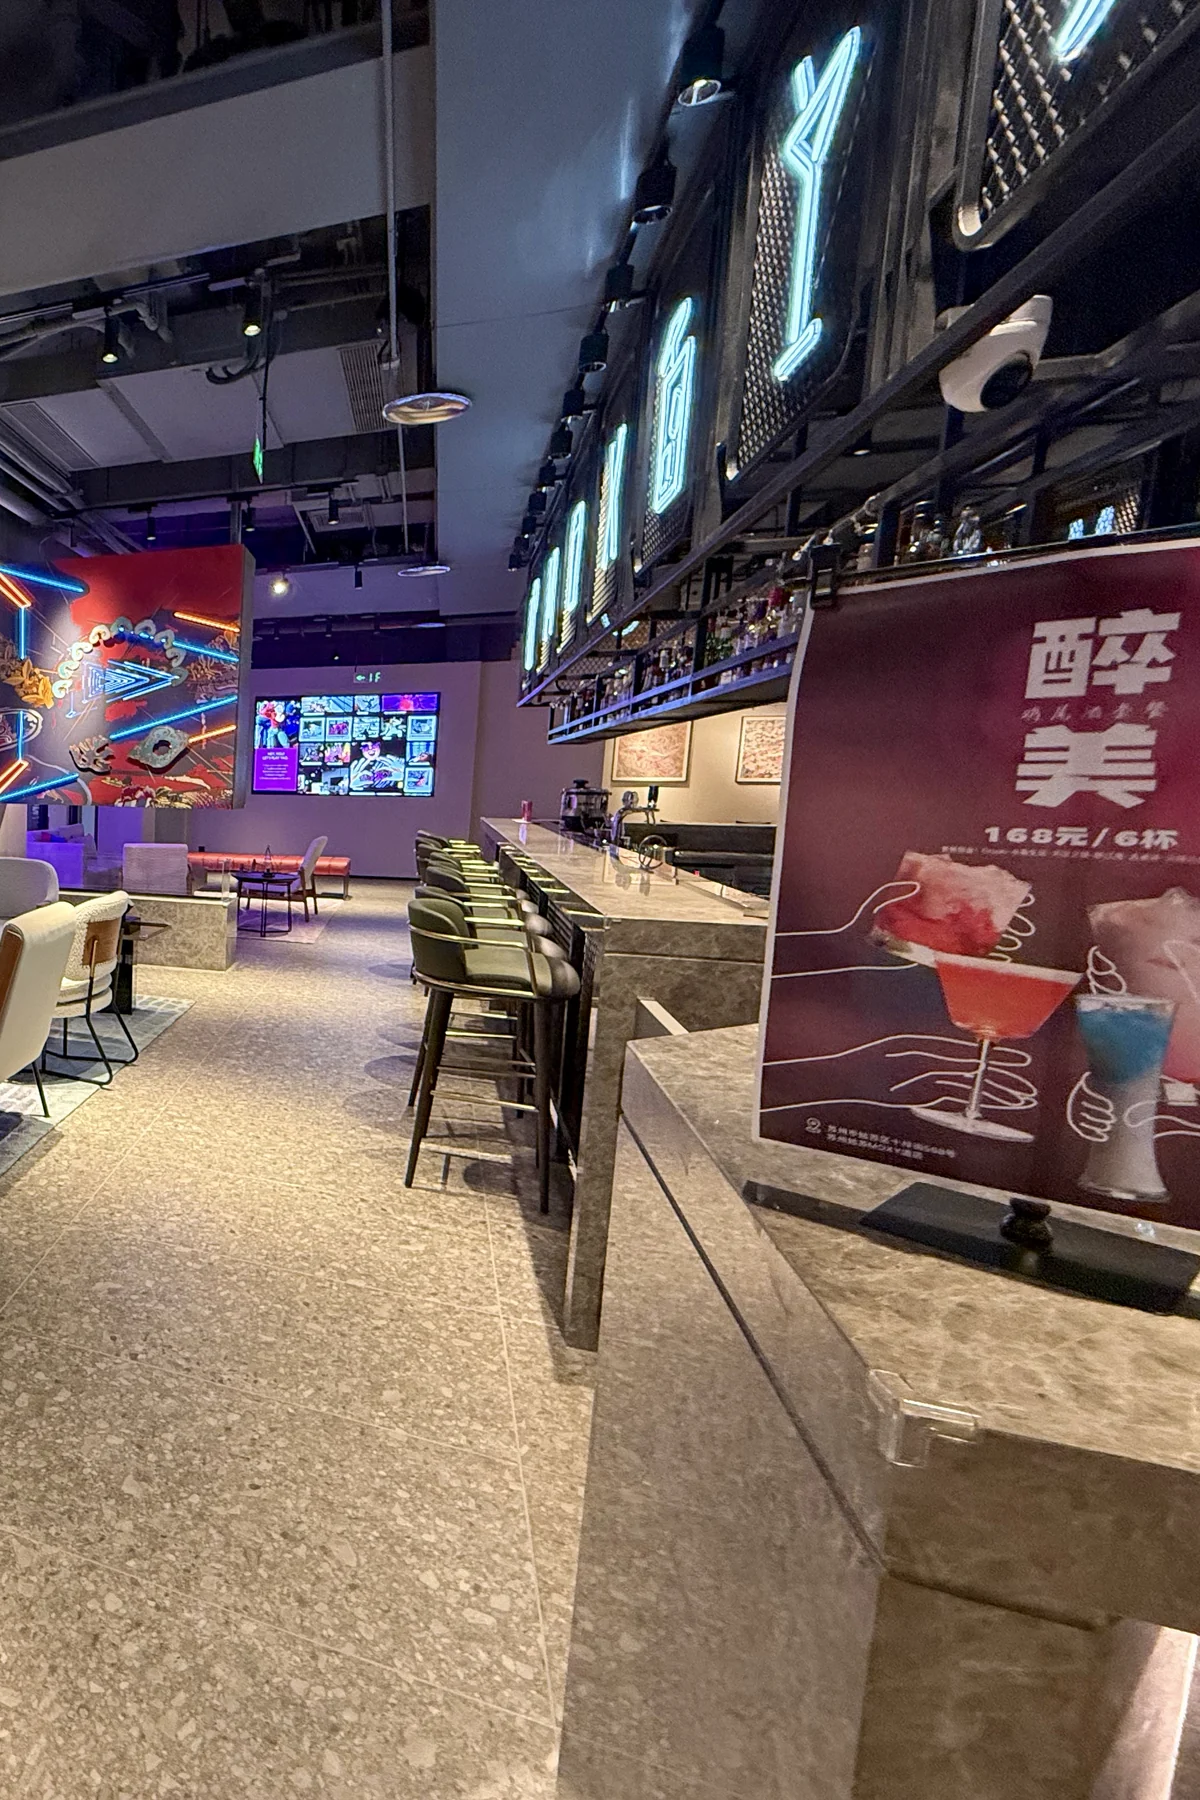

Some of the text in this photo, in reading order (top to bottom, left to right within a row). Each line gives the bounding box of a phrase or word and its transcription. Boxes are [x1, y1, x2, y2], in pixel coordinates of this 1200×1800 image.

[1025, 608, 1181, 699] 醉
[1015, 722, 1158, 808] 美
[984, 826, 1178, 850] 168元/6杯
